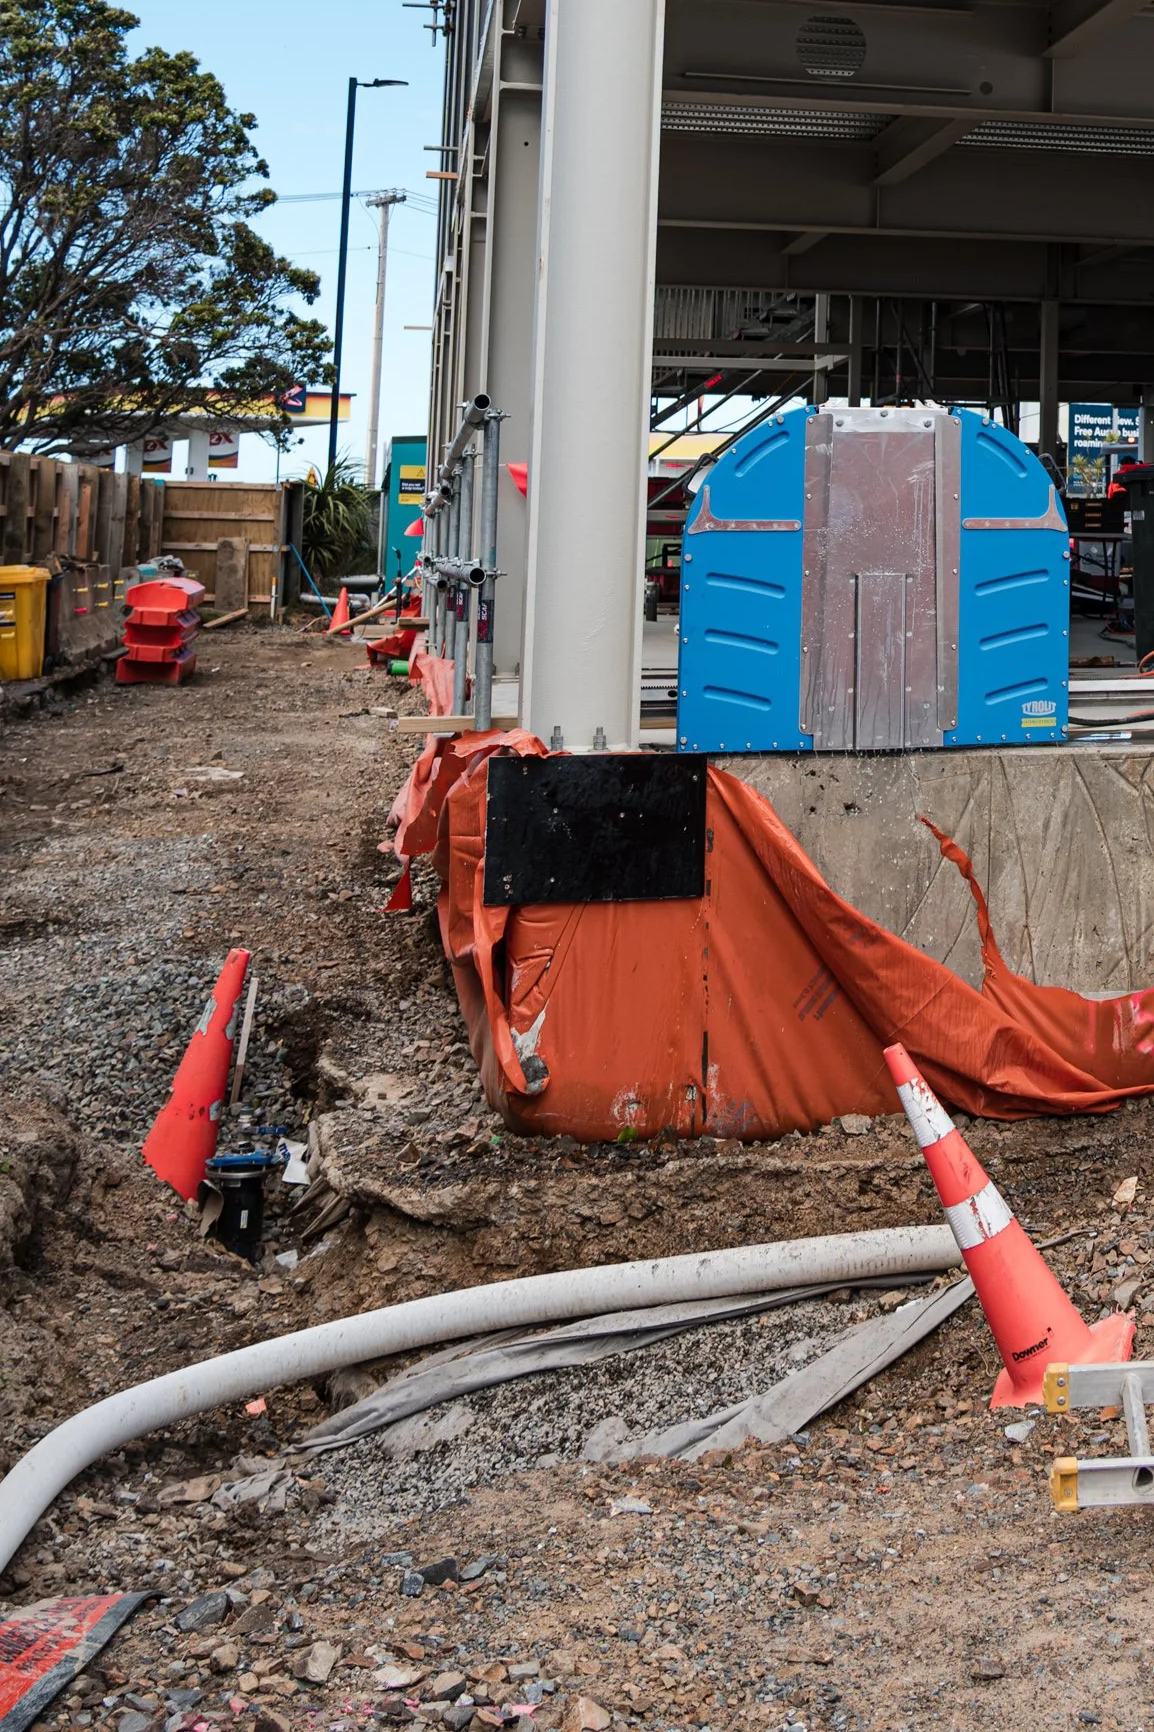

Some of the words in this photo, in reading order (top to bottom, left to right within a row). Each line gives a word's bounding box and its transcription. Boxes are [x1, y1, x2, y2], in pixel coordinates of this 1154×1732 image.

[1074, 414, 1111, 425] Different
[1074, 426, 1093, 436] Free
[1022, 700, 1056, 715] TYROLIT
[1011, 1338, 1048, 1362] Downer
